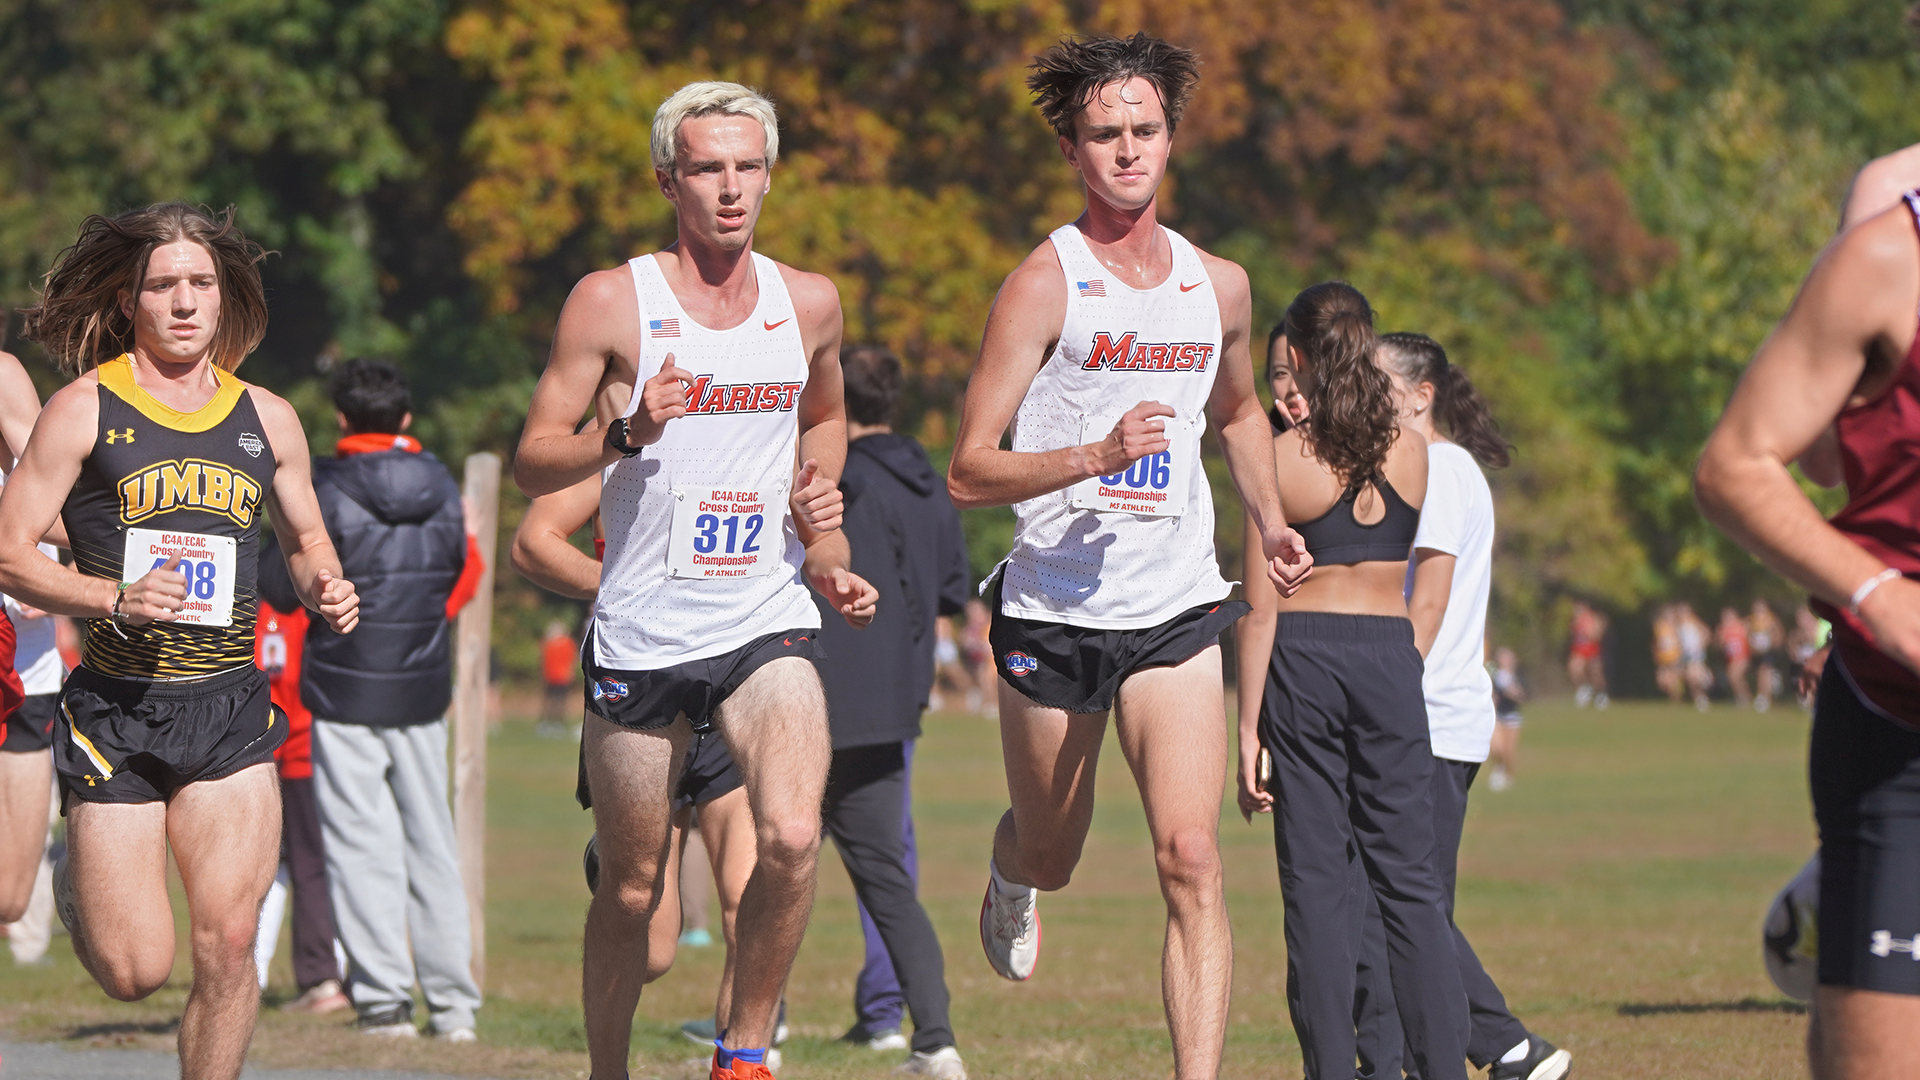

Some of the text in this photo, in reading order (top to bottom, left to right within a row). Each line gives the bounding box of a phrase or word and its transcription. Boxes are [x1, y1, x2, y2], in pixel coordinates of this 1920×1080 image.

[1081, 332, 1215, 373] MARIST
[119, 459, 261, 527] UMBC
[711, 490, 759, 502] IC4A/ECAC
[1098, 486, 1167, 502] Championships
[699, 501, 765, 513] Cross Country
[1121, 503, 1156, 513] ATHLETIC
[161, 534, 206, 547] IC4A/ECAC
[693, 514, 764, 553] 312
[150, 544, 215, 561] Cros Country
[692, 554, 758, 566] Championships
